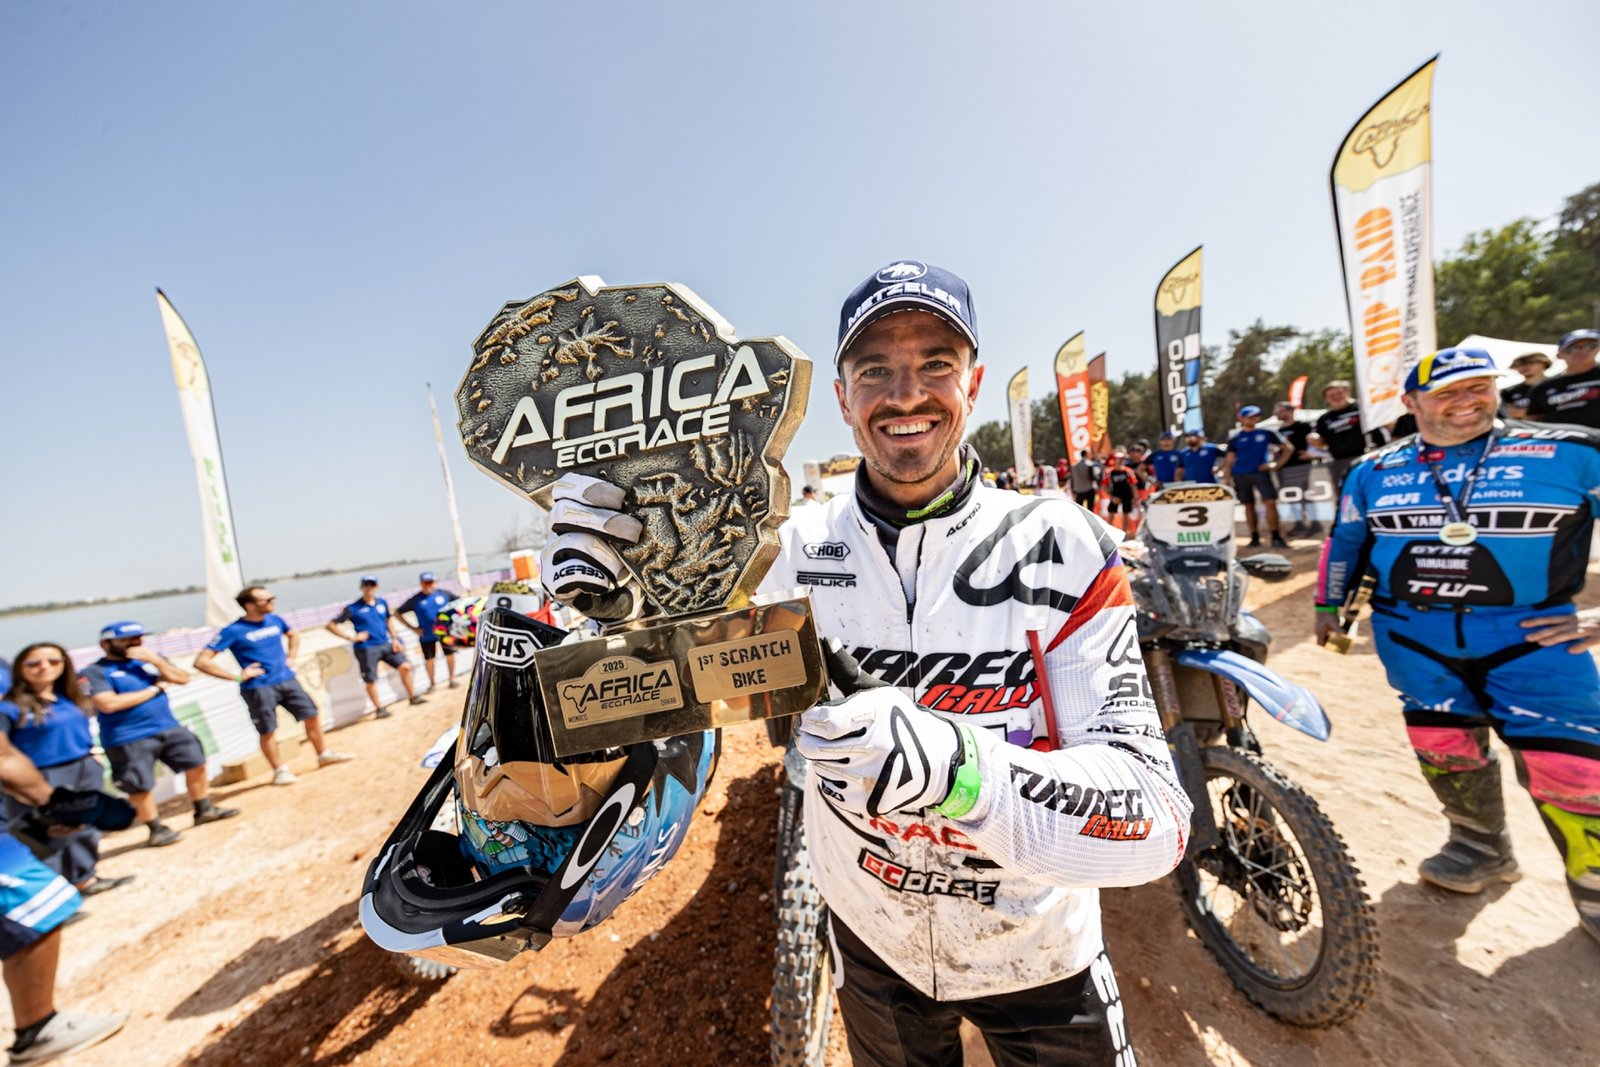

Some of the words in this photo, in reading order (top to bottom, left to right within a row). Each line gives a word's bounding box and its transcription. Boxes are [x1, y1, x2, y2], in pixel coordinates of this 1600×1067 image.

[848, 282, 962, 328] METZELER
[491, 345, 770, 466] AFRICA
[1063, 381, 1092, 466] OTUL
[1417, 462, 1524, 486] rders
[1471, 490, 1524, 499] AIROH
[1177, 505, 1209, 527] 3
[1408, 514, 1479, 527] YAMA
[1414, 557, 1470, 570] YAMALUBE
[602, 660, 624, 672] 2025
[697, 653, 714, 671] 1ST
[719, 640, 792, 667] SCRATCH
[579, 669, 673, 707] AFRICA
[732, 668, 767, 689] BIKE
[869, 816, 979, 852] RAC
[1079, 812, 1154, 841] RALLY
